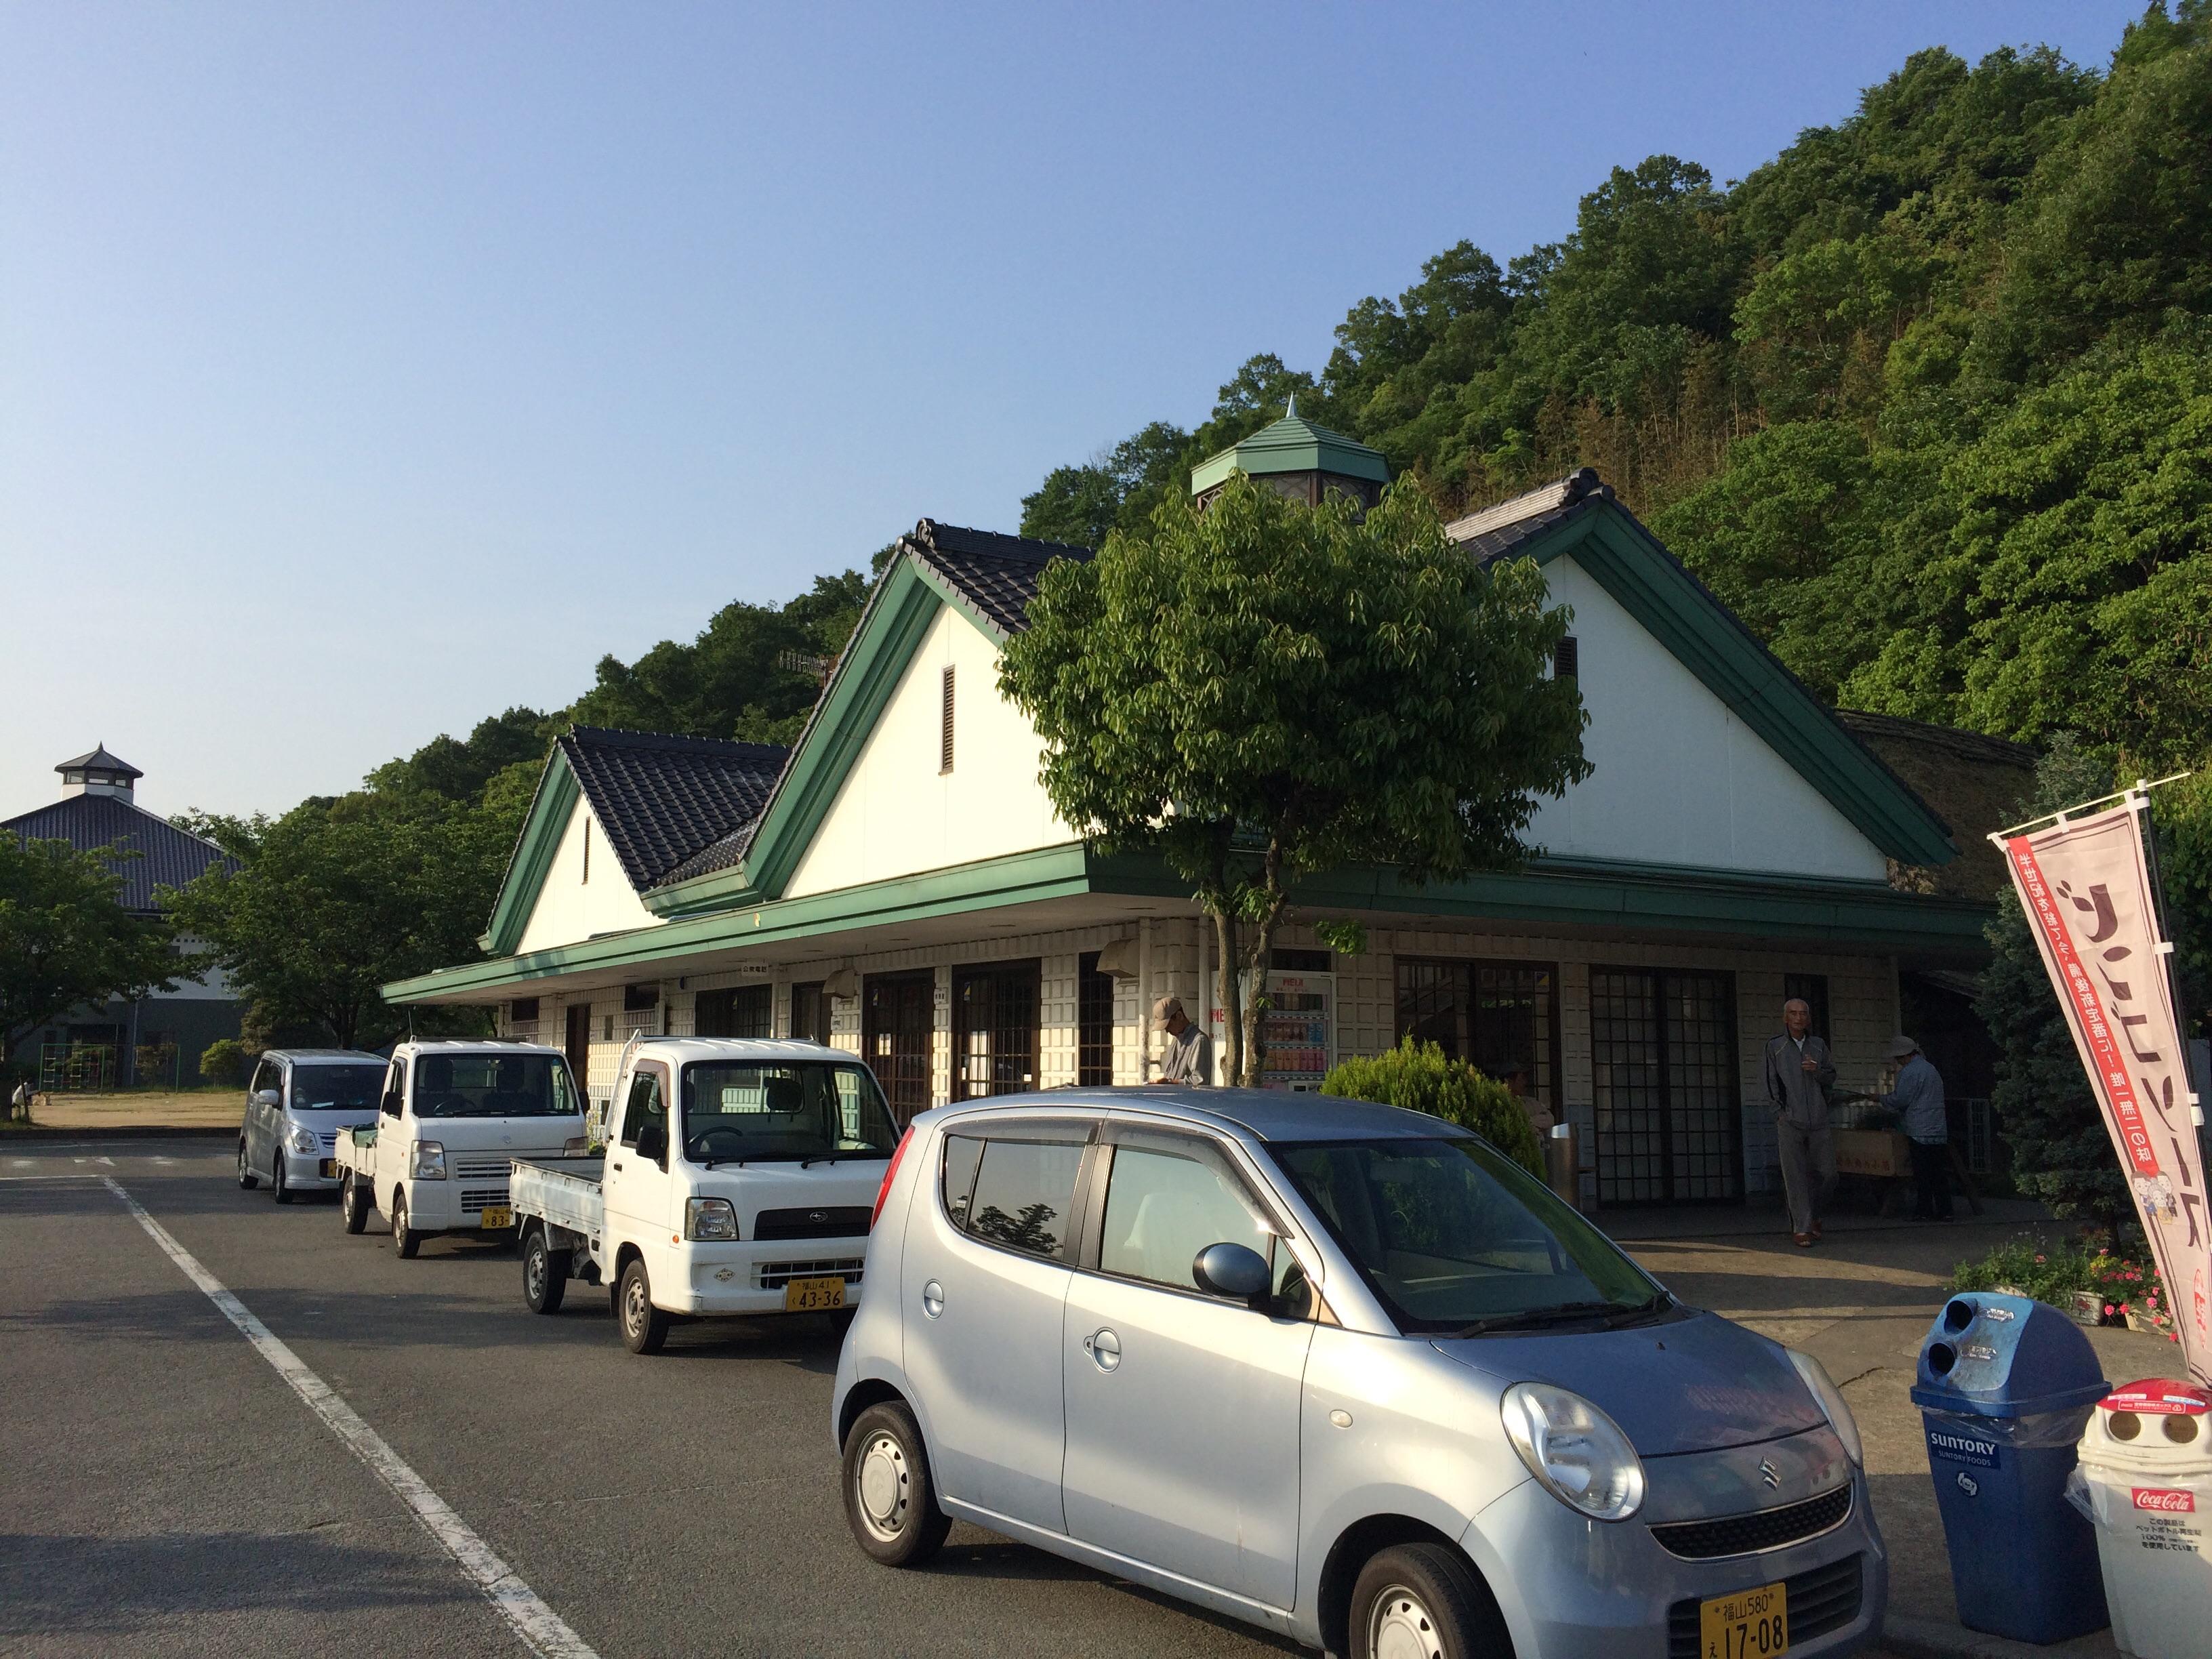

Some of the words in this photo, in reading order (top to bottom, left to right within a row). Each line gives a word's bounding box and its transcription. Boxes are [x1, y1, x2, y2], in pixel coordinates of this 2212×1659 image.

[799, 1290, 840, 1307] 43-36
[1938, 1450, 1966, 1462] SUNTORY
[1968, 1456, 1992, 1466] FOODS
[2136, 1490, 2191, 1510] Coca-Cola
[2142, 1533, 2166, 1541] 100%
[1725, 1615, 1784, 1659] 17-08
